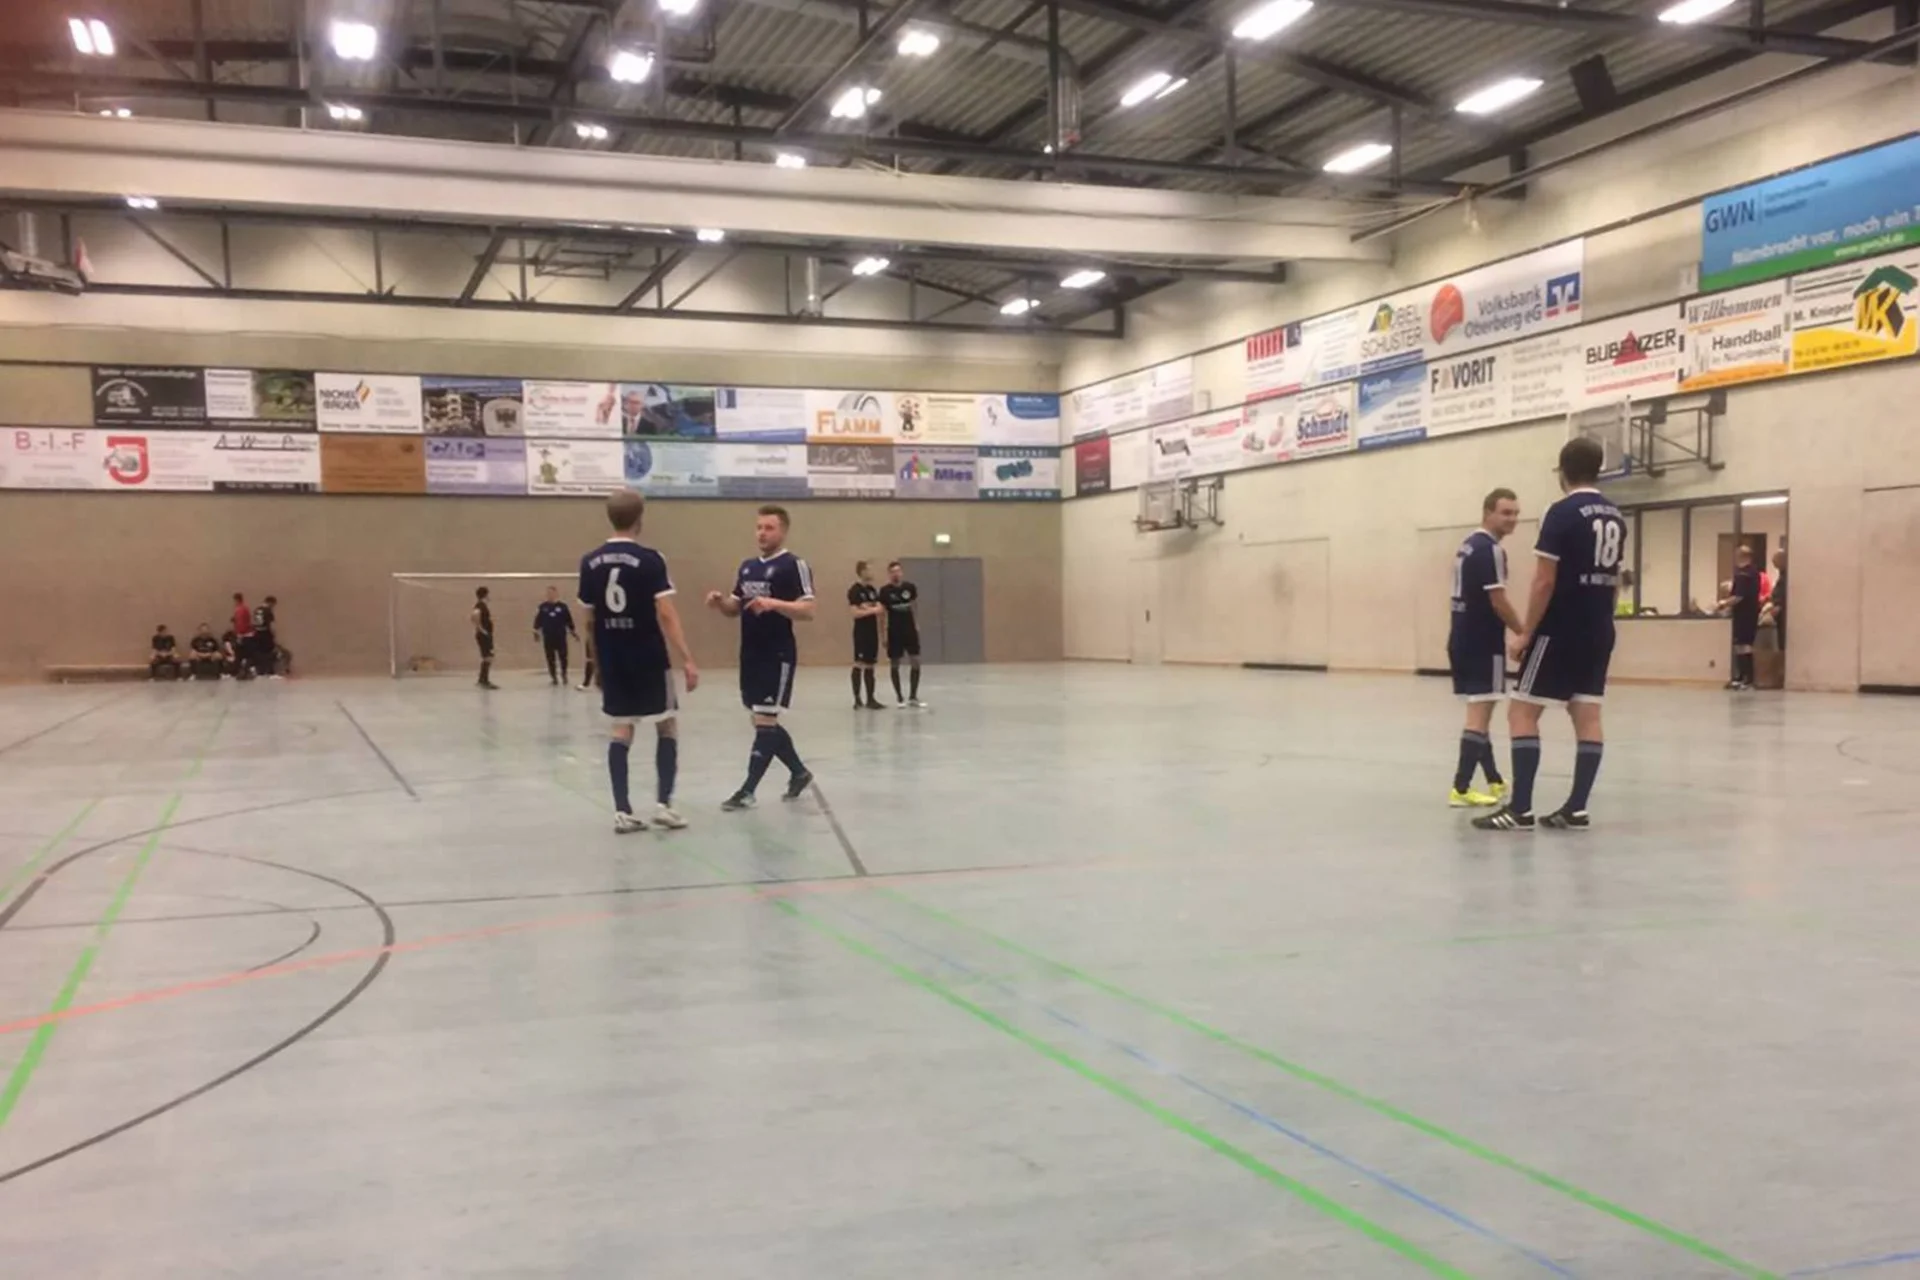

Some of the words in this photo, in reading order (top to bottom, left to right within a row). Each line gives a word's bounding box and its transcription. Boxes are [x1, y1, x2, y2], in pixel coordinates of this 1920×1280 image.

[1705, 199, 1755, 233] GWN
[1478, 285, 1541, 316] Volksbank
[1688, 294, 1782, 323] Willkommen
[1464, 311, 1523, 338] Oberberg
[1524, 304, 1542, 322] eG
[1712, 324, 1782, 350] Handball
[1361, 326, 1422, 357] SCHUSTER
[1586, 328, 1676, 365] BUBENZER
[1431, 356, 1496, 393] FAVORIT
[816, 410, 881, 434] FLAMM
[1297, 409, 1349, 440] Schmidt
[1592, 518, 1621, 568] 18
[605, 567, 627, 613] 6
